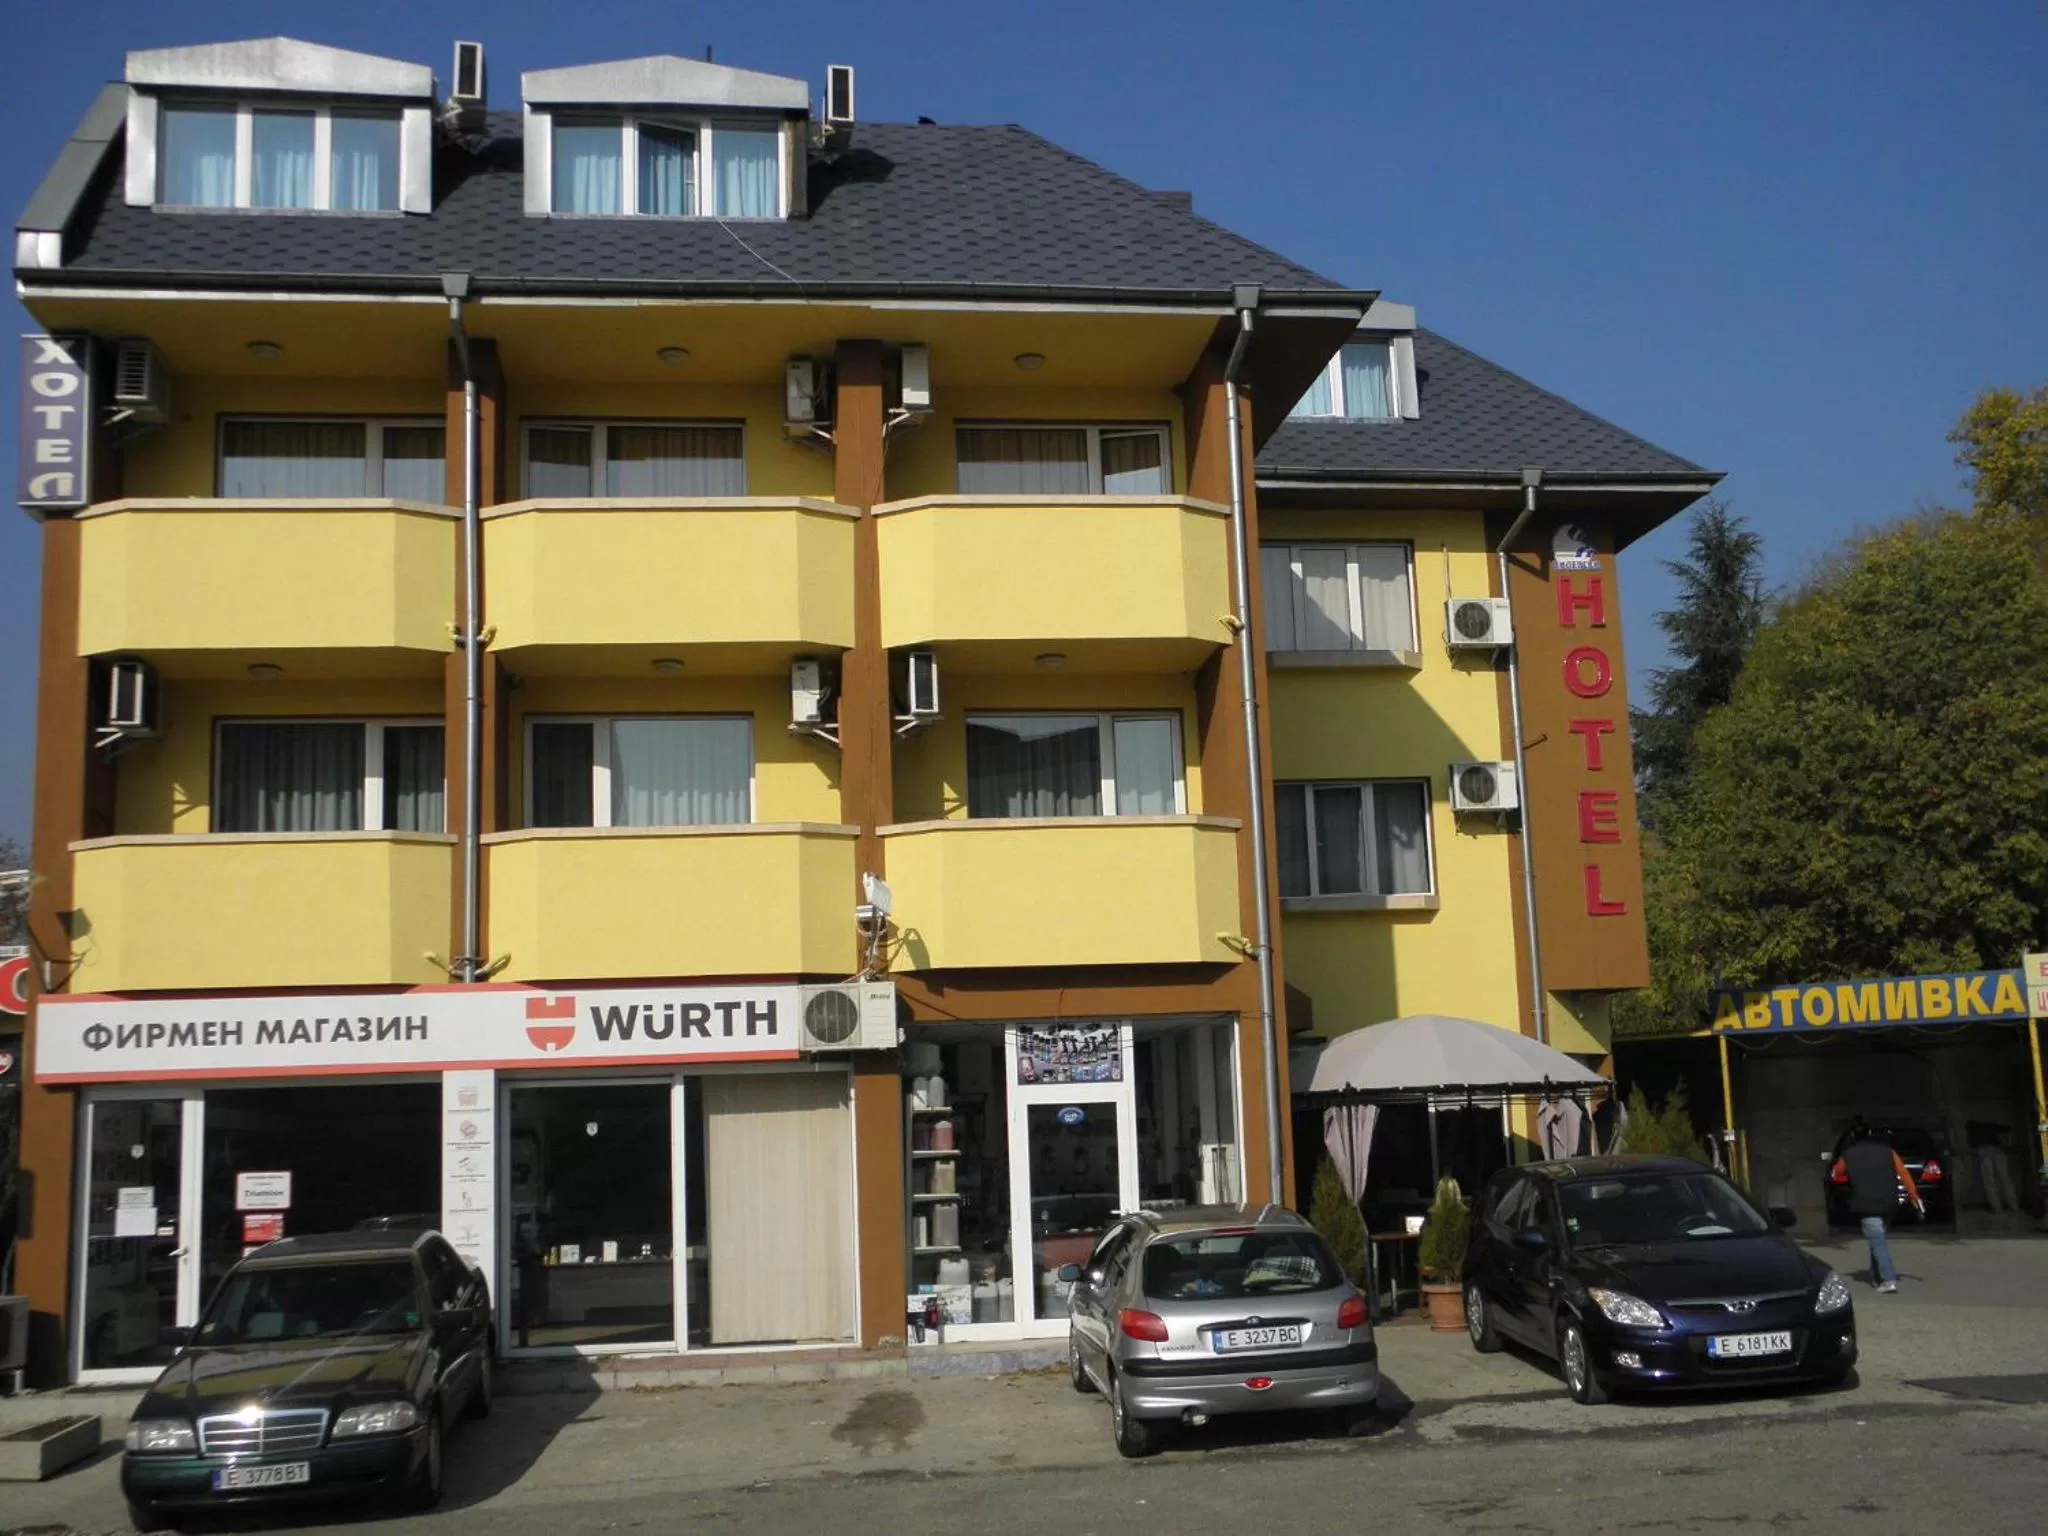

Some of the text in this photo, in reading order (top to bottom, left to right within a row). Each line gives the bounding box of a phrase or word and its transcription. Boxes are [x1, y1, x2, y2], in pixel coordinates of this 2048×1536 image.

[29, 339, 79, 498] ХОТЕЛ
[1556, 575, 1627, 917] HOTEL
[590, 1000, 778, 1042] WÜRTH
[1713, 974, 2026, 1031] АВТОМИВКА
[82, 1015, 428, 1051] ФИРМЕН МАГАЗИН
